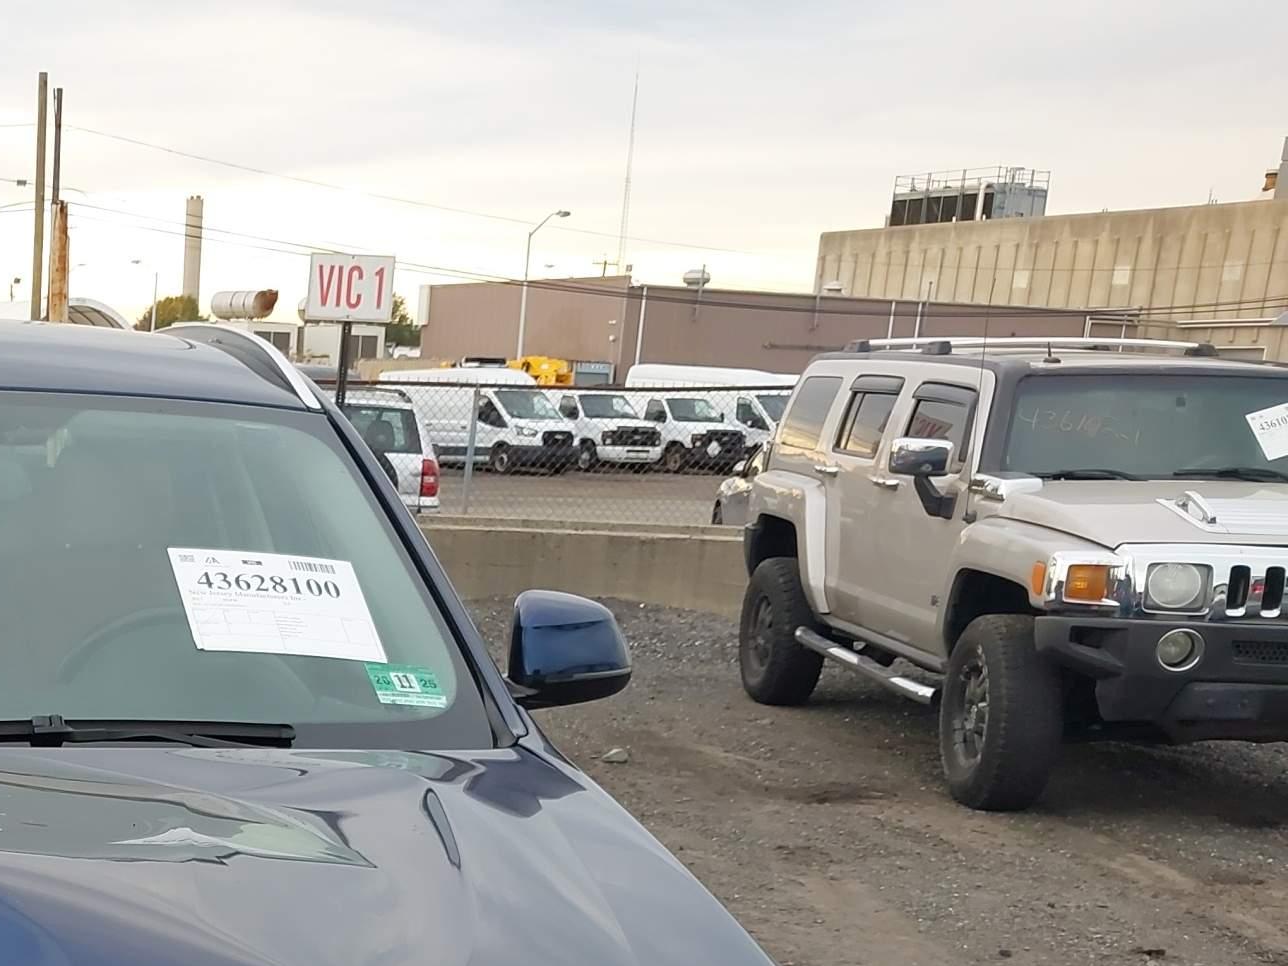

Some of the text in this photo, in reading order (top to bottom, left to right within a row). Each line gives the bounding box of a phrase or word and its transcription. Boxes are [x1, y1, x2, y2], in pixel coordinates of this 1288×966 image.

[318, 264, 386, 310] VIC 1
[1259, 414, 1288, 431] 43610
[197, 571, 341, 599] 43628100
[394, 674, 416, 689] 11
